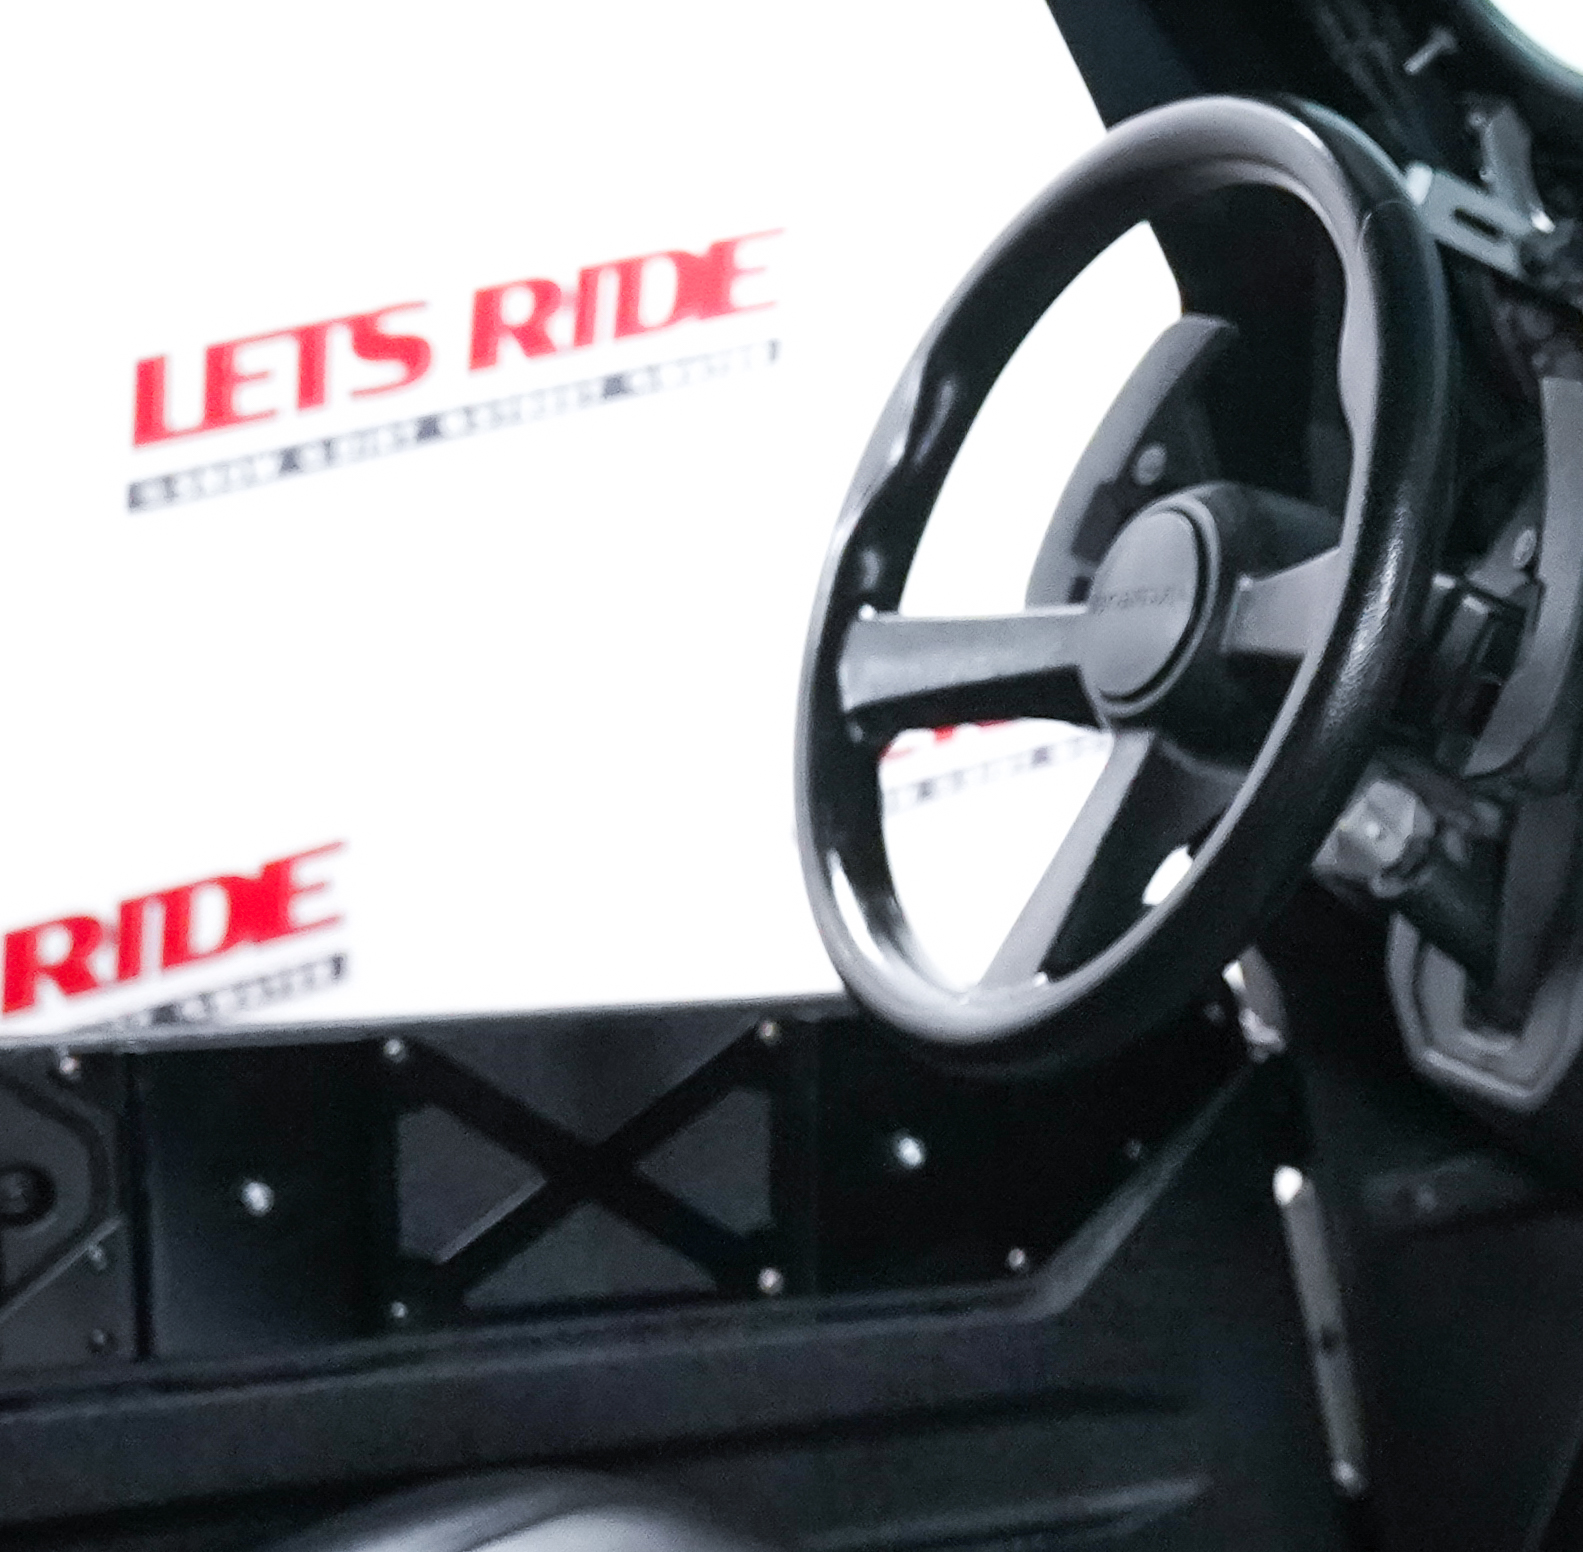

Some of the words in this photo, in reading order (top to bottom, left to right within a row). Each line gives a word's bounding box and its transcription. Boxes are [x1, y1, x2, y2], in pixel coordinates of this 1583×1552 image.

[132, 299, 433, 448] LETS
[469, 226, 786, 372] RIDE
[2, 841, 347, 1016] RIDE
